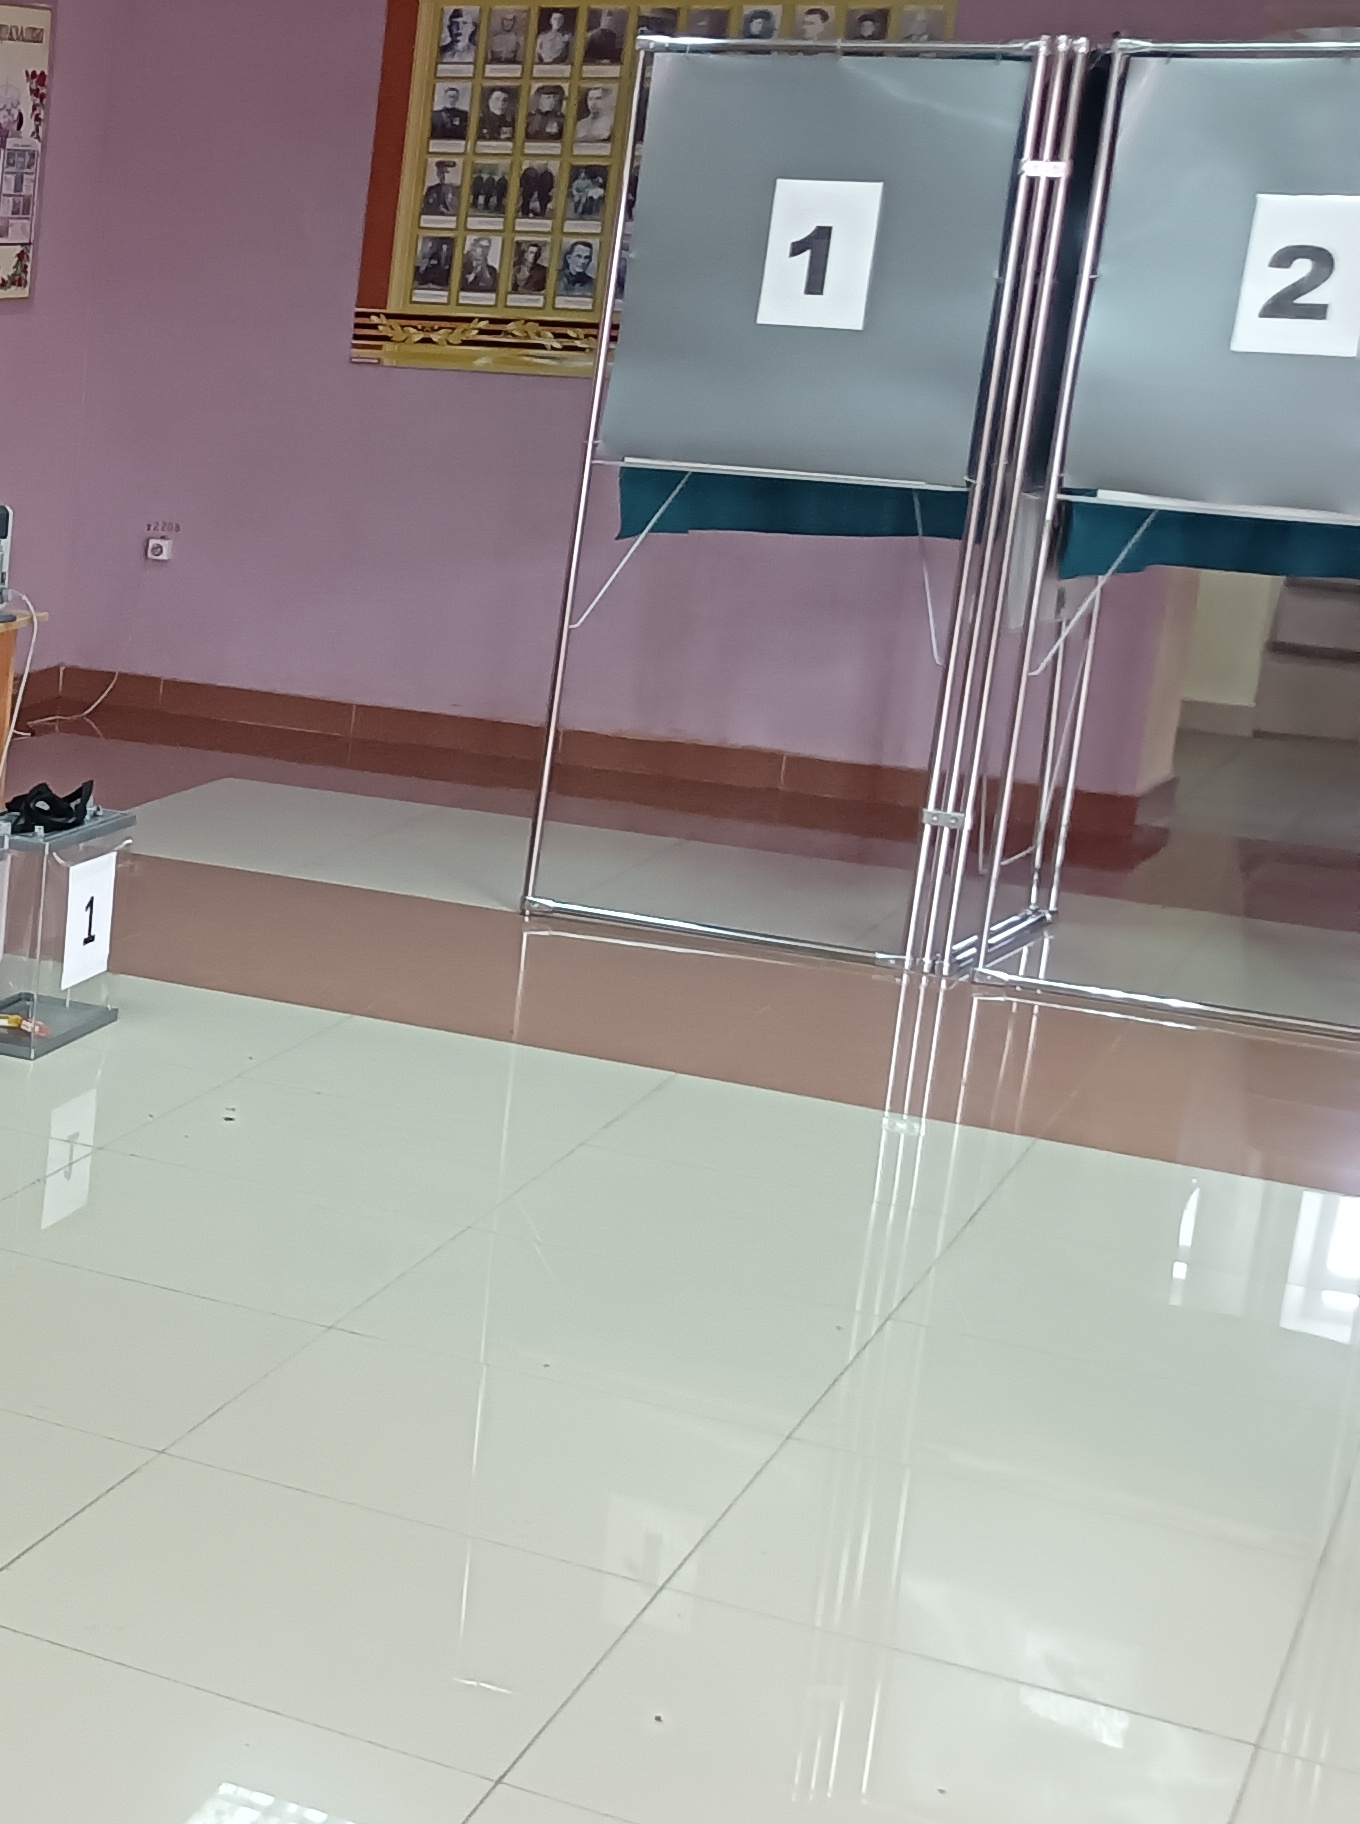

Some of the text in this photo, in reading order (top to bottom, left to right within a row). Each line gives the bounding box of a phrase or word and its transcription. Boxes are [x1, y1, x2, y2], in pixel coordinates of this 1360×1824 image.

[788, 226, 833, 295] 1
[1258, 245, 1335, 319] 2
[83, 896, 95, 946] 1
